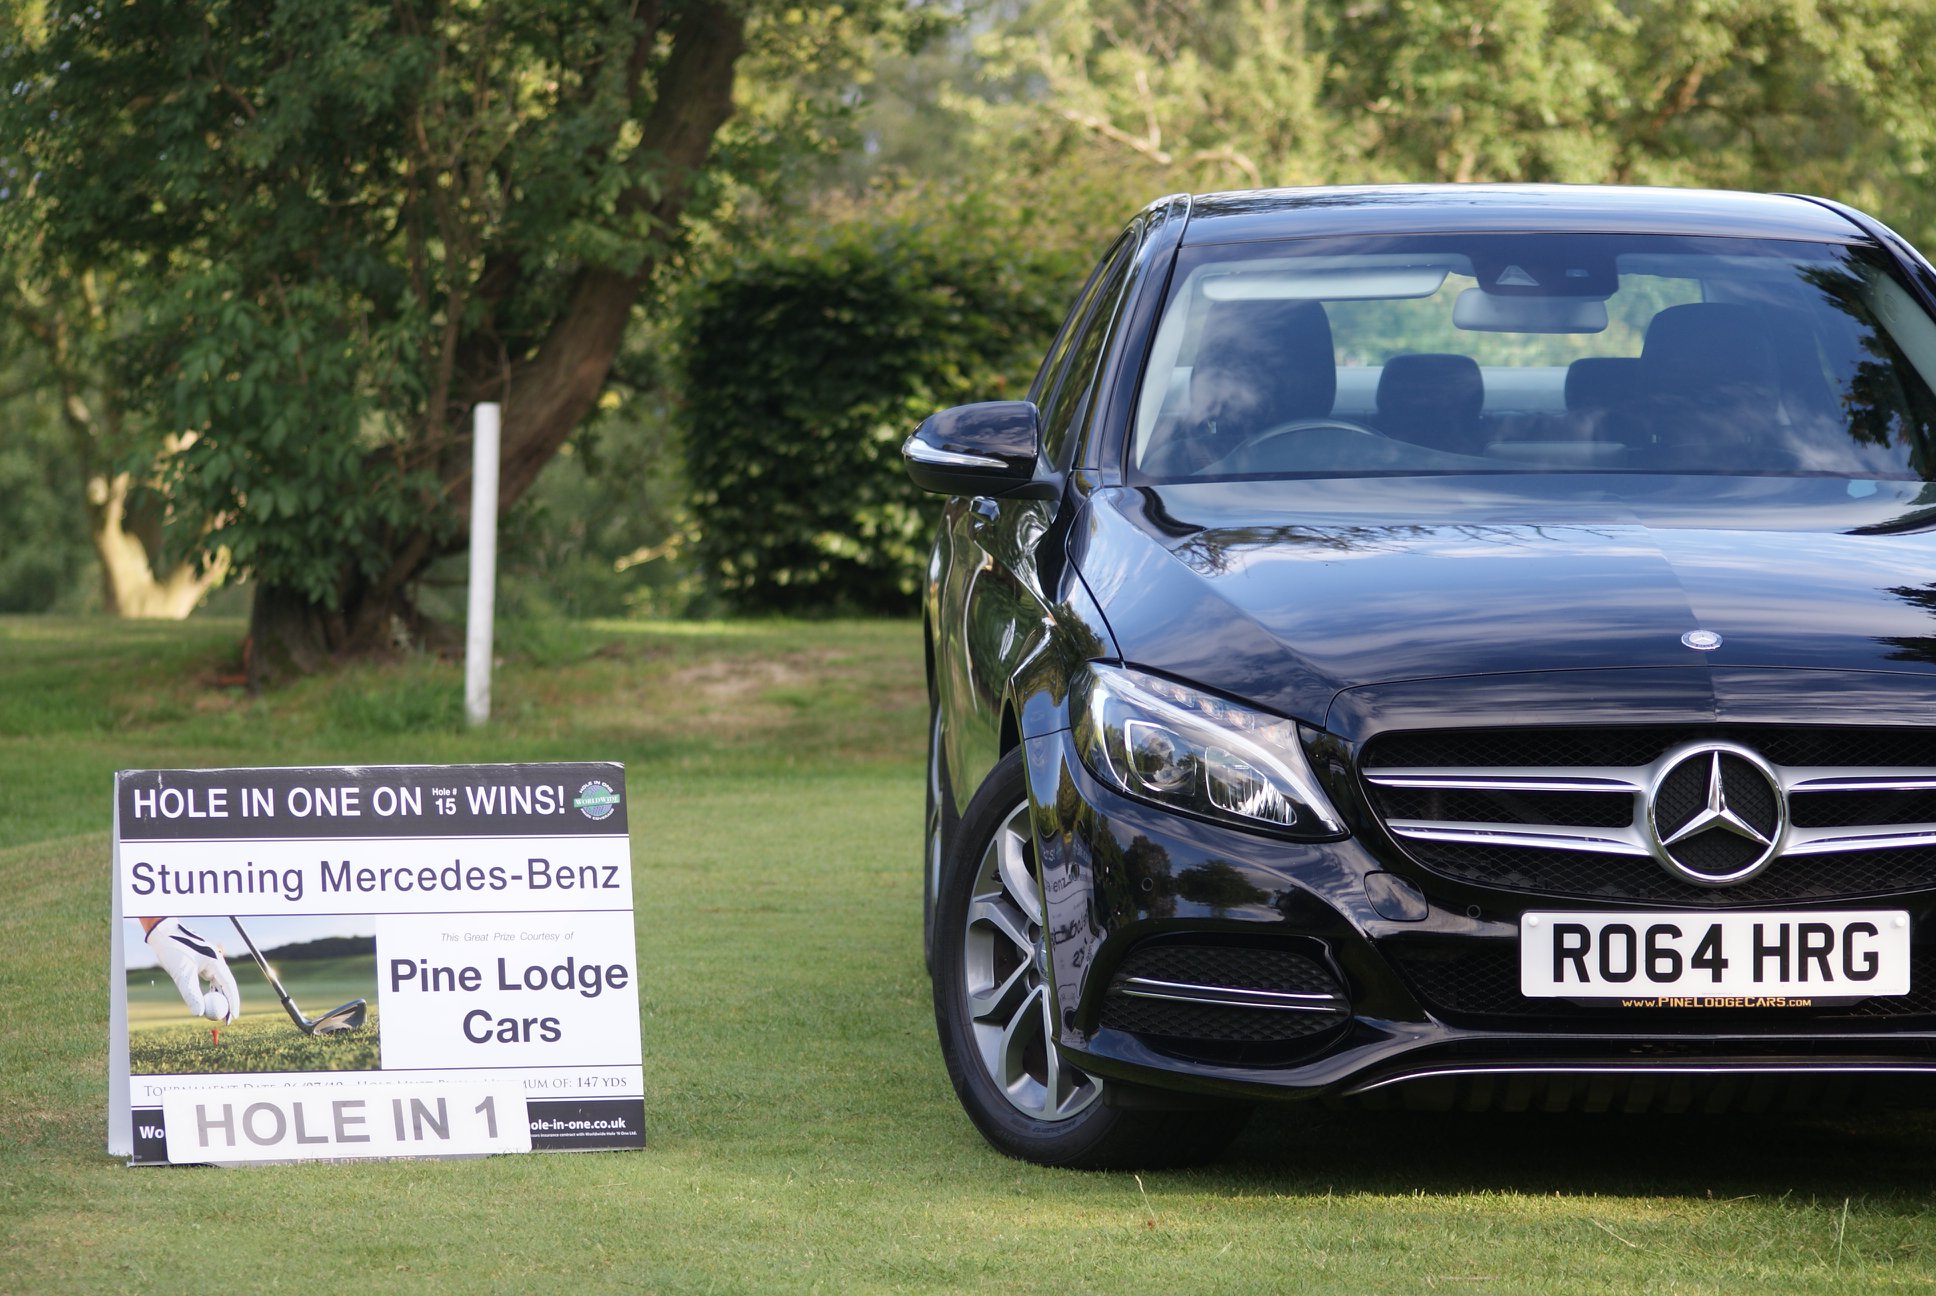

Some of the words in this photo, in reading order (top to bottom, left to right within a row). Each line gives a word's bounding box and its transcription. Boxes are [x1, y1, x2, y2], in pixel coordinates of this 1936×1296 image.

[134, 788, 229, 819] HOLE
[241, 787, 275, 817] IN
[287, 786, 361, 817] ONE
[372, 786, 422, 816] ON
[465, 785, 566, 815] WINS!
[432, 787, 451, 796] Hole
[451, 787, 458, 796] #
[435, 798, 457, 815] 15
[131, 861, 304, 901] Stunning
[320, 857, 621, 893] Mercedes-Benz
[441, 932, 460, 942] This
[464, 932, 489, 942] Great
[493, 932, 516, 941] Prize
[520, 931, 560, 942] Courtesy
[564, 931, 575, 940] of
[1552, 922, 1729, 983] RO64
[1752, 922, 1879, 983] HRG
[390, 958, 482, 993] Pine
[497, 956, 629, 998] Lodge
[463, 1009, 562, 1044] Cars
[552, 1078, 572, 1088] OF:
[577, 1076, 599, 1088] 147
[602, 1077, 627, 1087] YDS
[195, 1099, 371, 1148] HOLE
[391, 1097, 451, 1142] IN
[474, 1095, 499, 1139] 1
[530, 1117, 626, 1131] ole-in-one.co.uk
